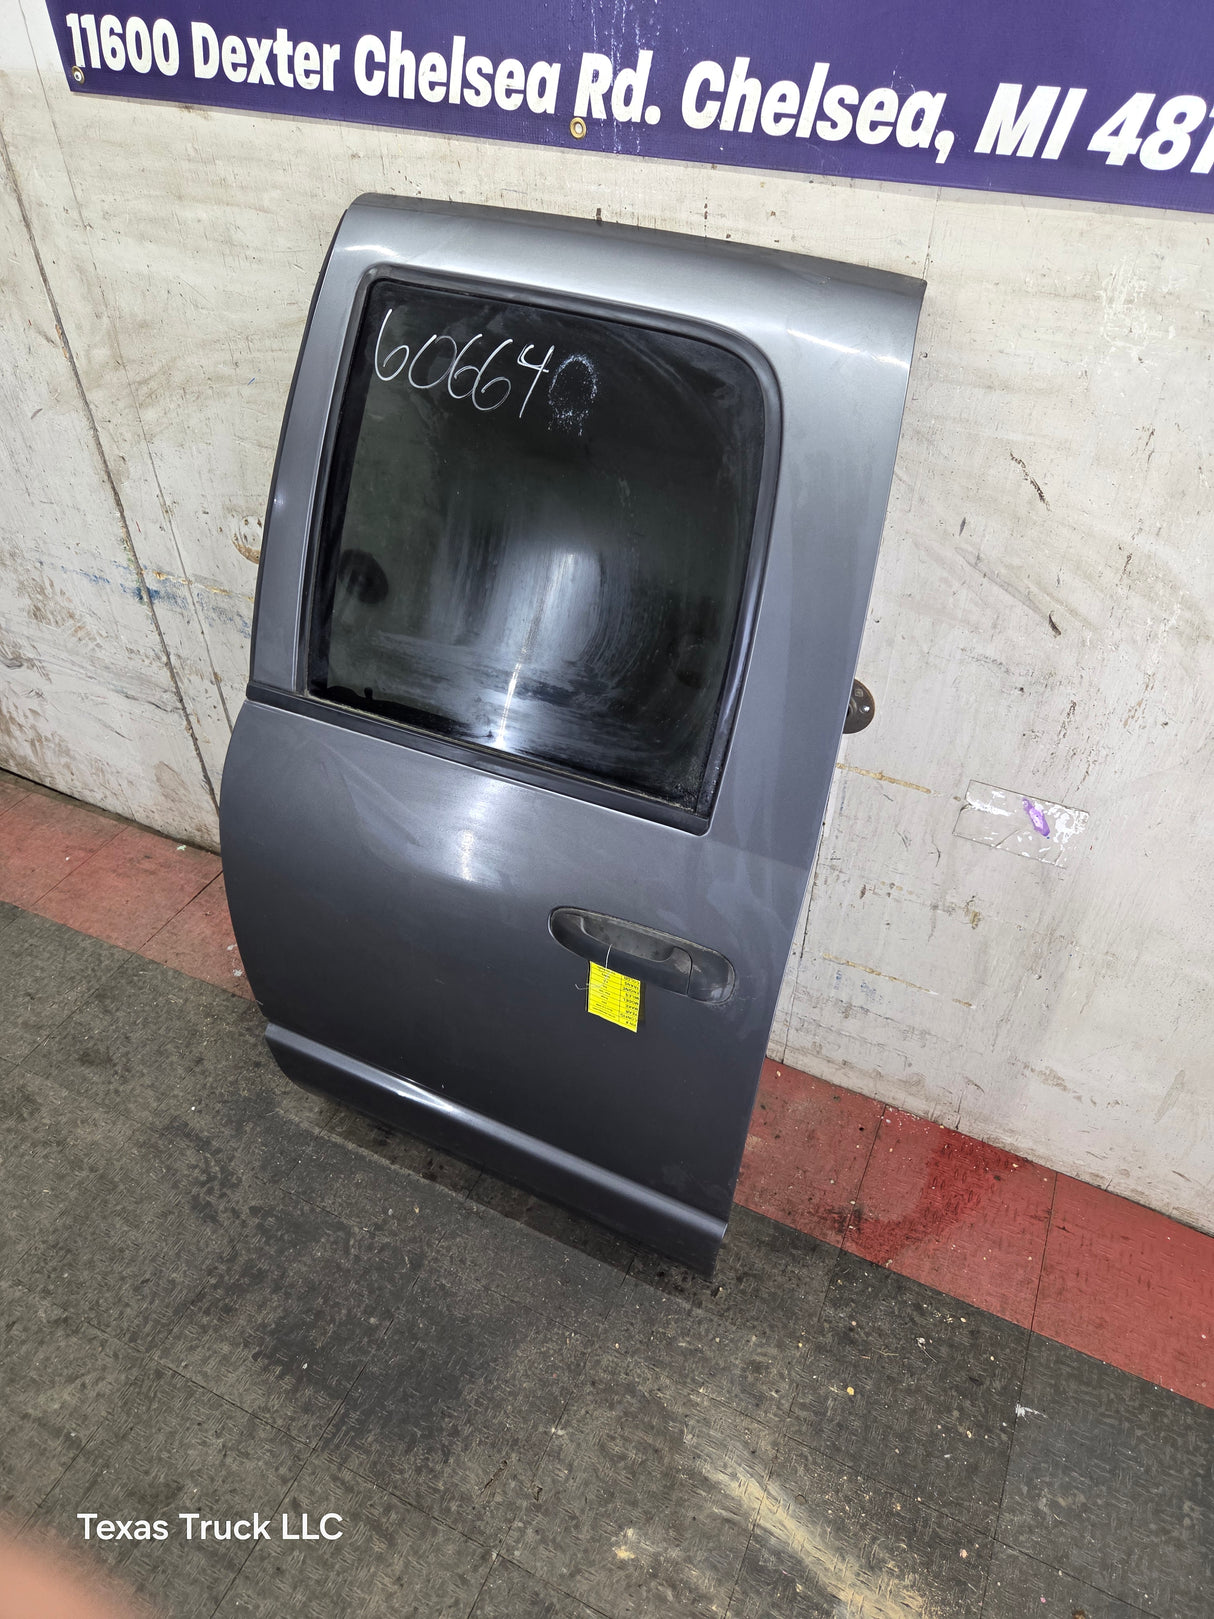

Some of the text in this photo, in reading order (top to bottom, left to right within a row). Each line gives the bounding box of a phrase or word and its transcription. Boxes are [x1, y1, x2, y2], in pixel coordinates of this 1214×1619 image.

[66, 14, 180, 76] 11600
[191, 21, 340, 91] Dexter
[354, 31, 562, 115] Chelsea
[573, 50, 660, 124] Rd.
[681, 57, 953, 164] Chelsea,
[974, 83, 1088, 160] MI
